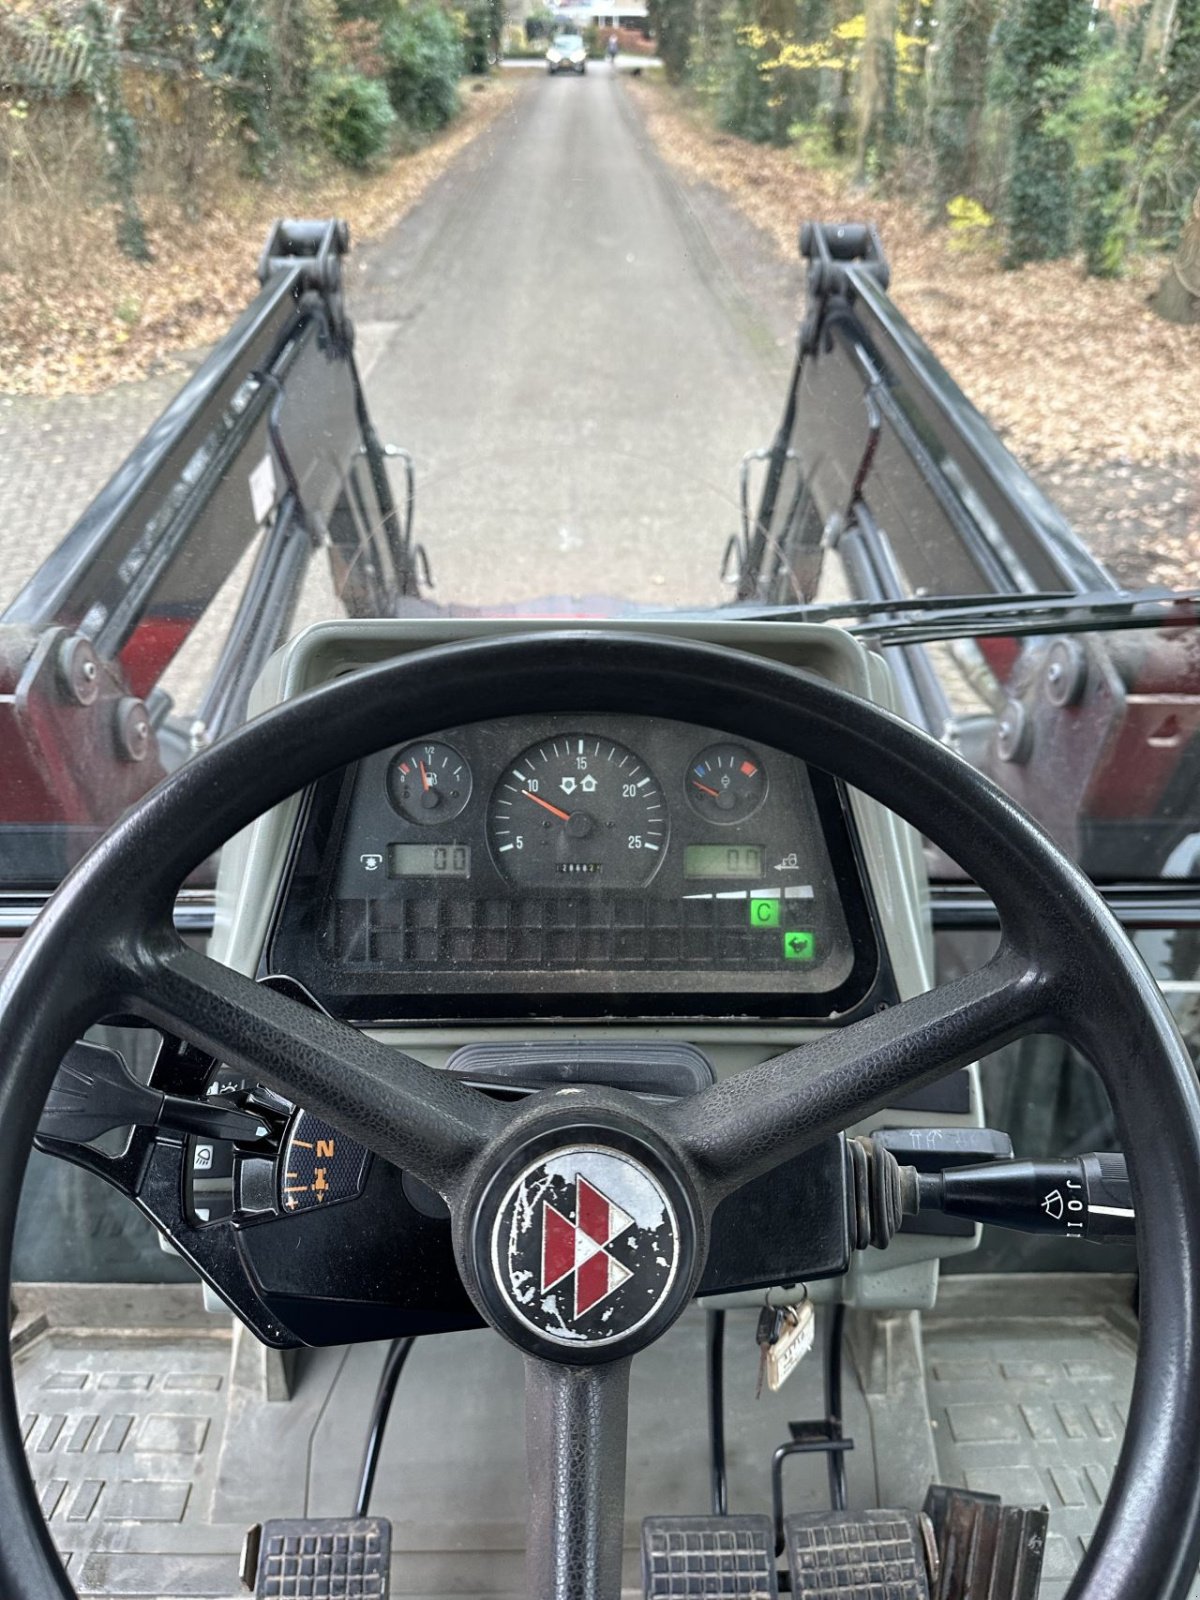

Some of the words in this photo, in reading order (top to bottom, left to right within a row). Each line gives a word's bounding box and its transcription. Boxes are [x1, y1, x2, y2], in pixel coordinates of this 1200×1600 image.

[424, 746, 435, 754] 1/2
[576, 756, 587, 770] 15
[527, 779, 539, 792] 10
[622, 784, 636, 797] 20
[516, 835, 523, 849] 5
[628, 835, 642, 849] 25
[757, 903, 771, 921] C
[316, 1139, 335, 1157] N
